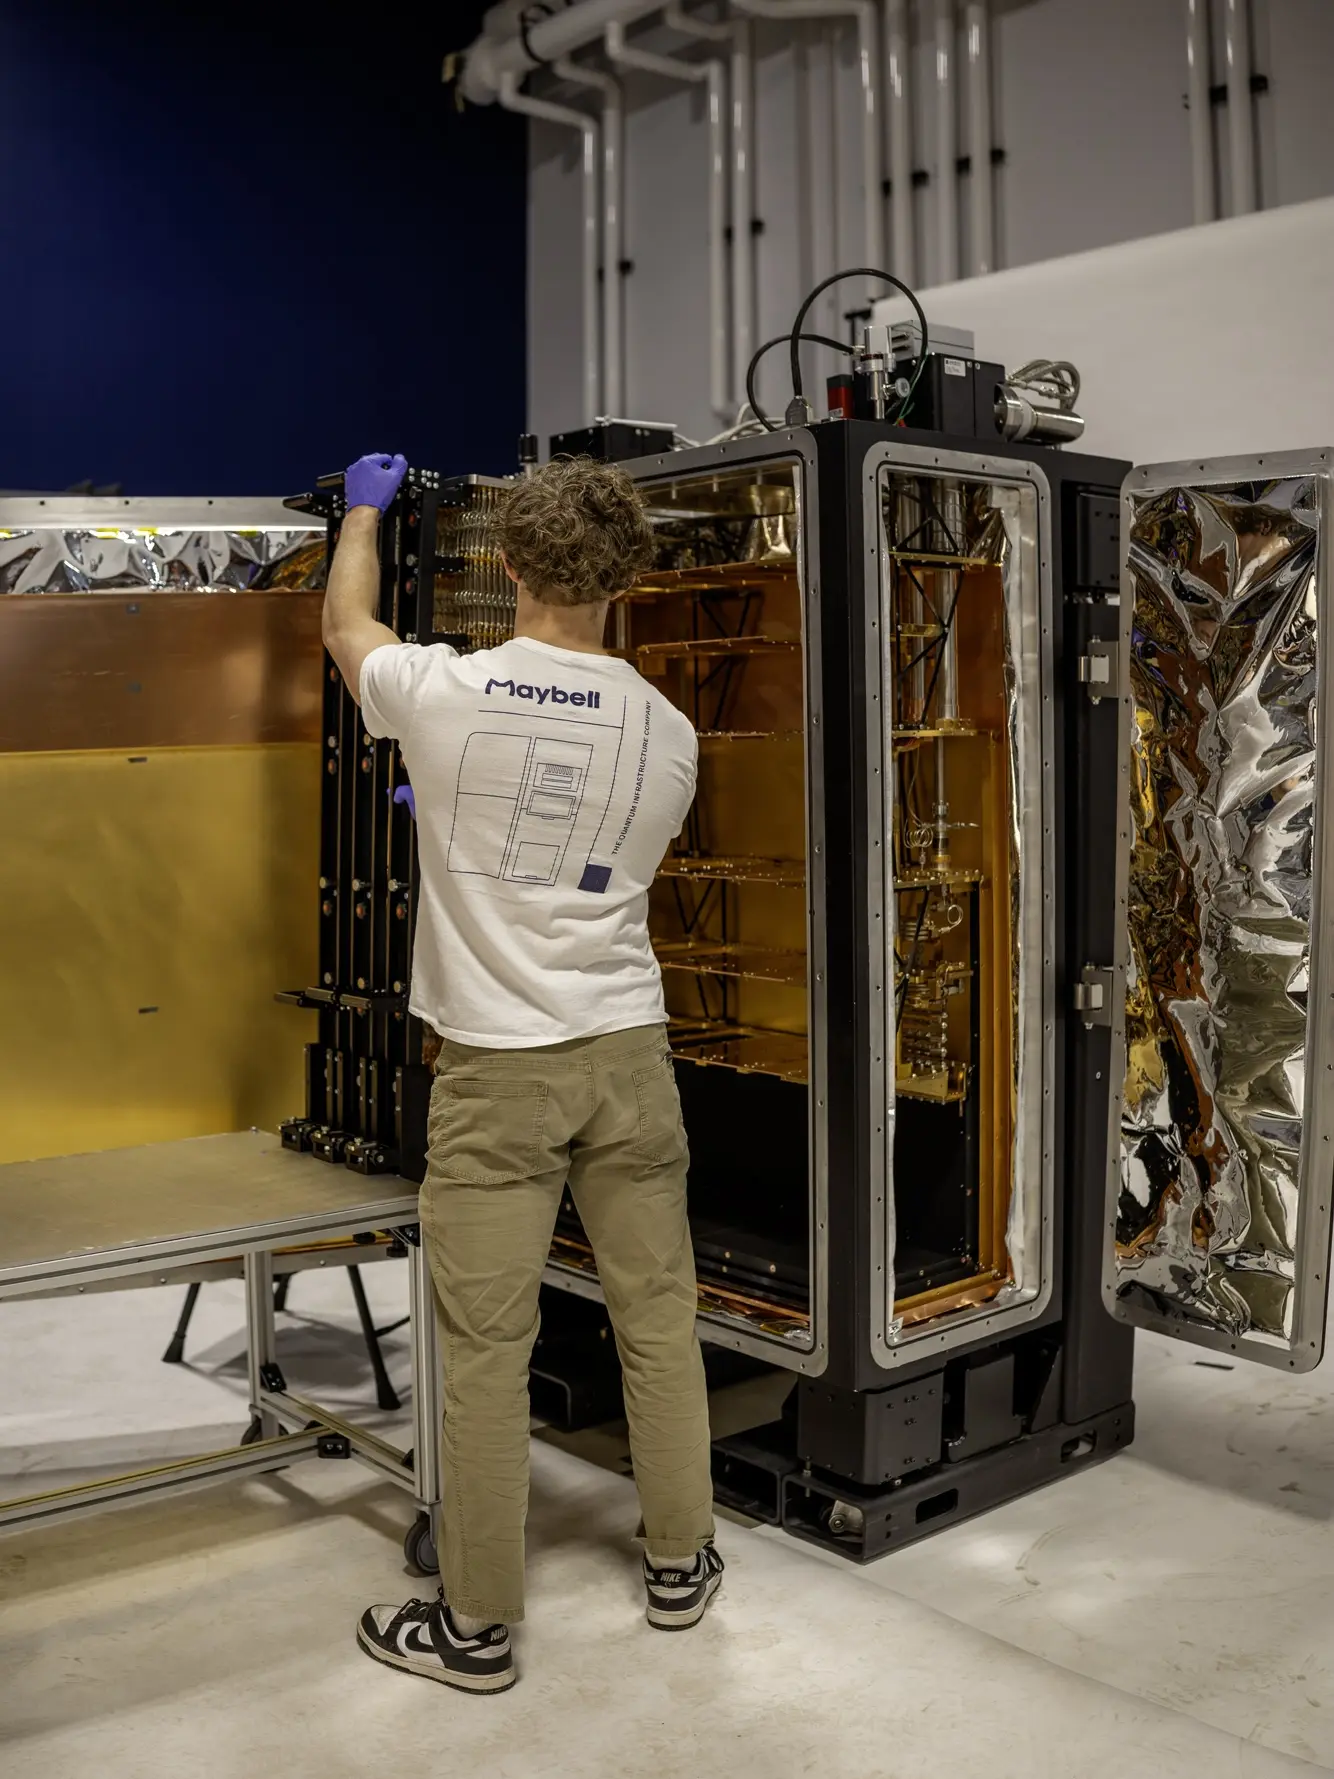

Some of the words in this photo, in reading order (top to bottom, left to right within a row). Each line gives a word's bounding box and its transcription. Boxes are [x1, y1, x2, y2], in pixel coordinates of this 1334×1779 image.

[485, 678, 600, 708] Maybell
[611, 841, 622, 855] THE
[619, 805, 637, 840] QUANTUM
[633, 737, 649, 804] INFRASTRUCTURE
[643, 700, 652, 736] COMPANY
[660, 1572, 682, 1583] NIKE
